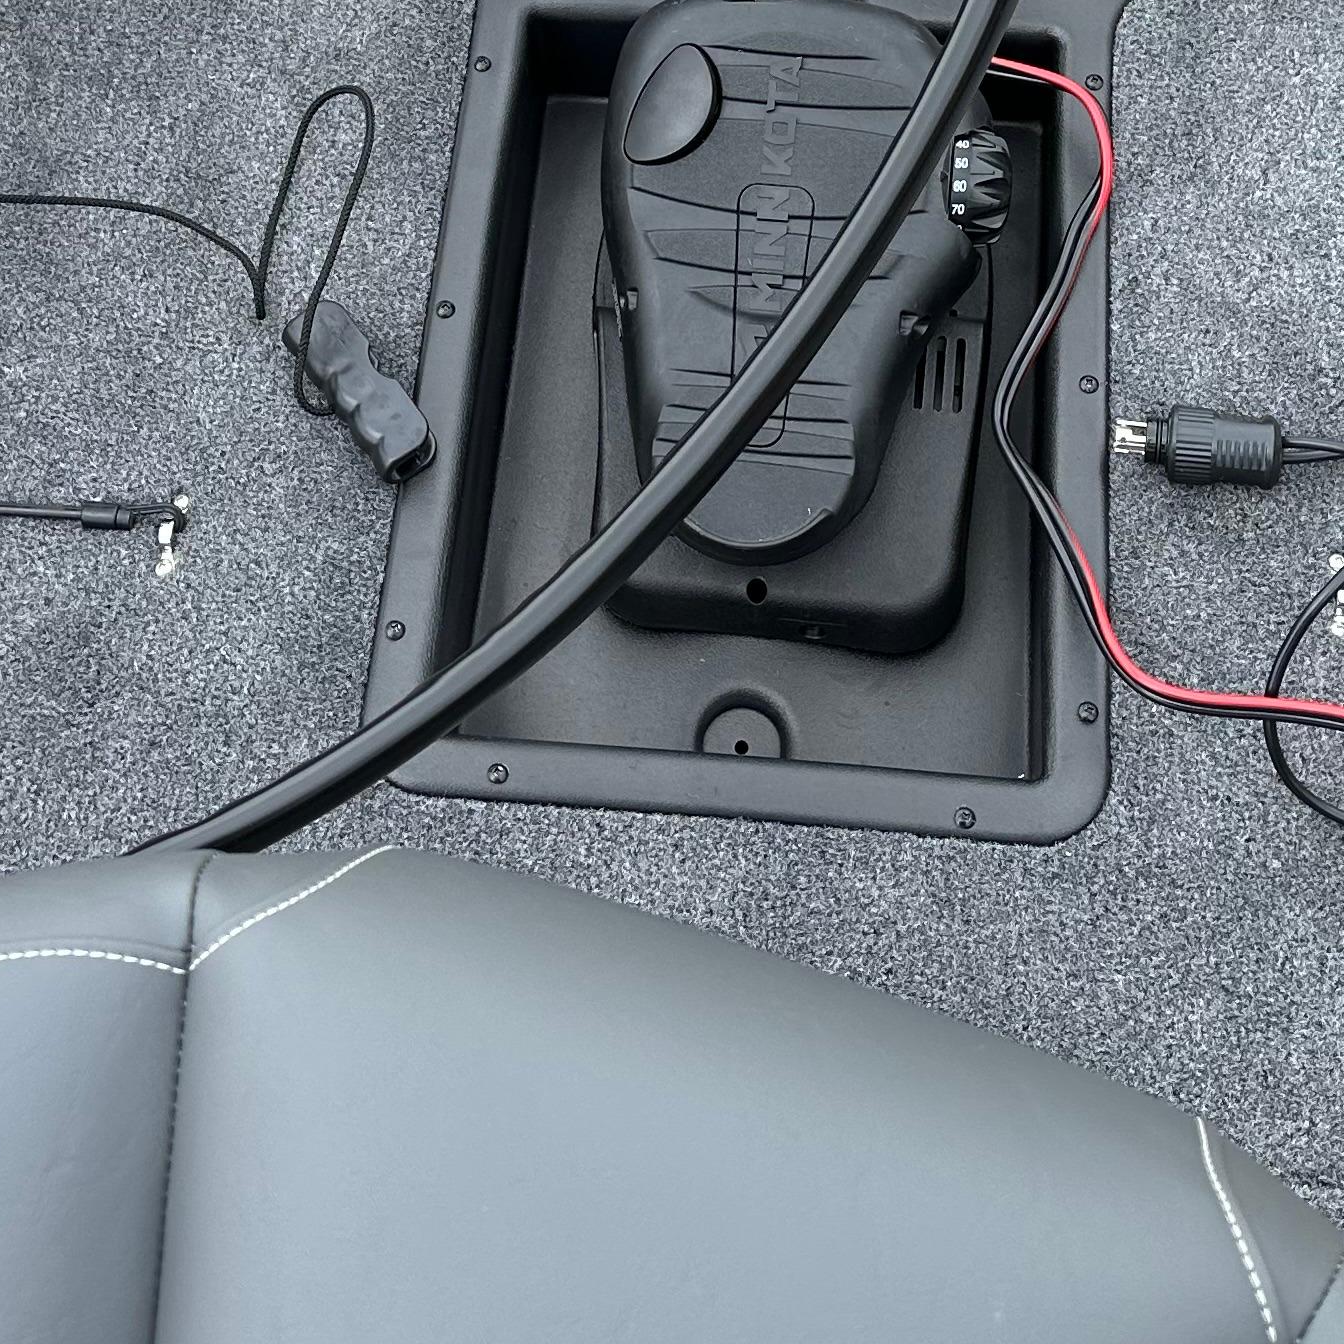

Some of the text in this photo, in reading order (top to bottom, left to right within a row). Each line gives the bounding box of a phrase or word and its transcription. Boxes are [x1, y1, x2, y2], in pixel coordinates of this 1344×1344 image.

[955, 139, 970, 149] 40
[954, 157, 969, 169] 50
[749, 56, 803, 312] MINN KOTA
[952, 179, 968, 192] 60
[951, 203, 965, 215] 70
